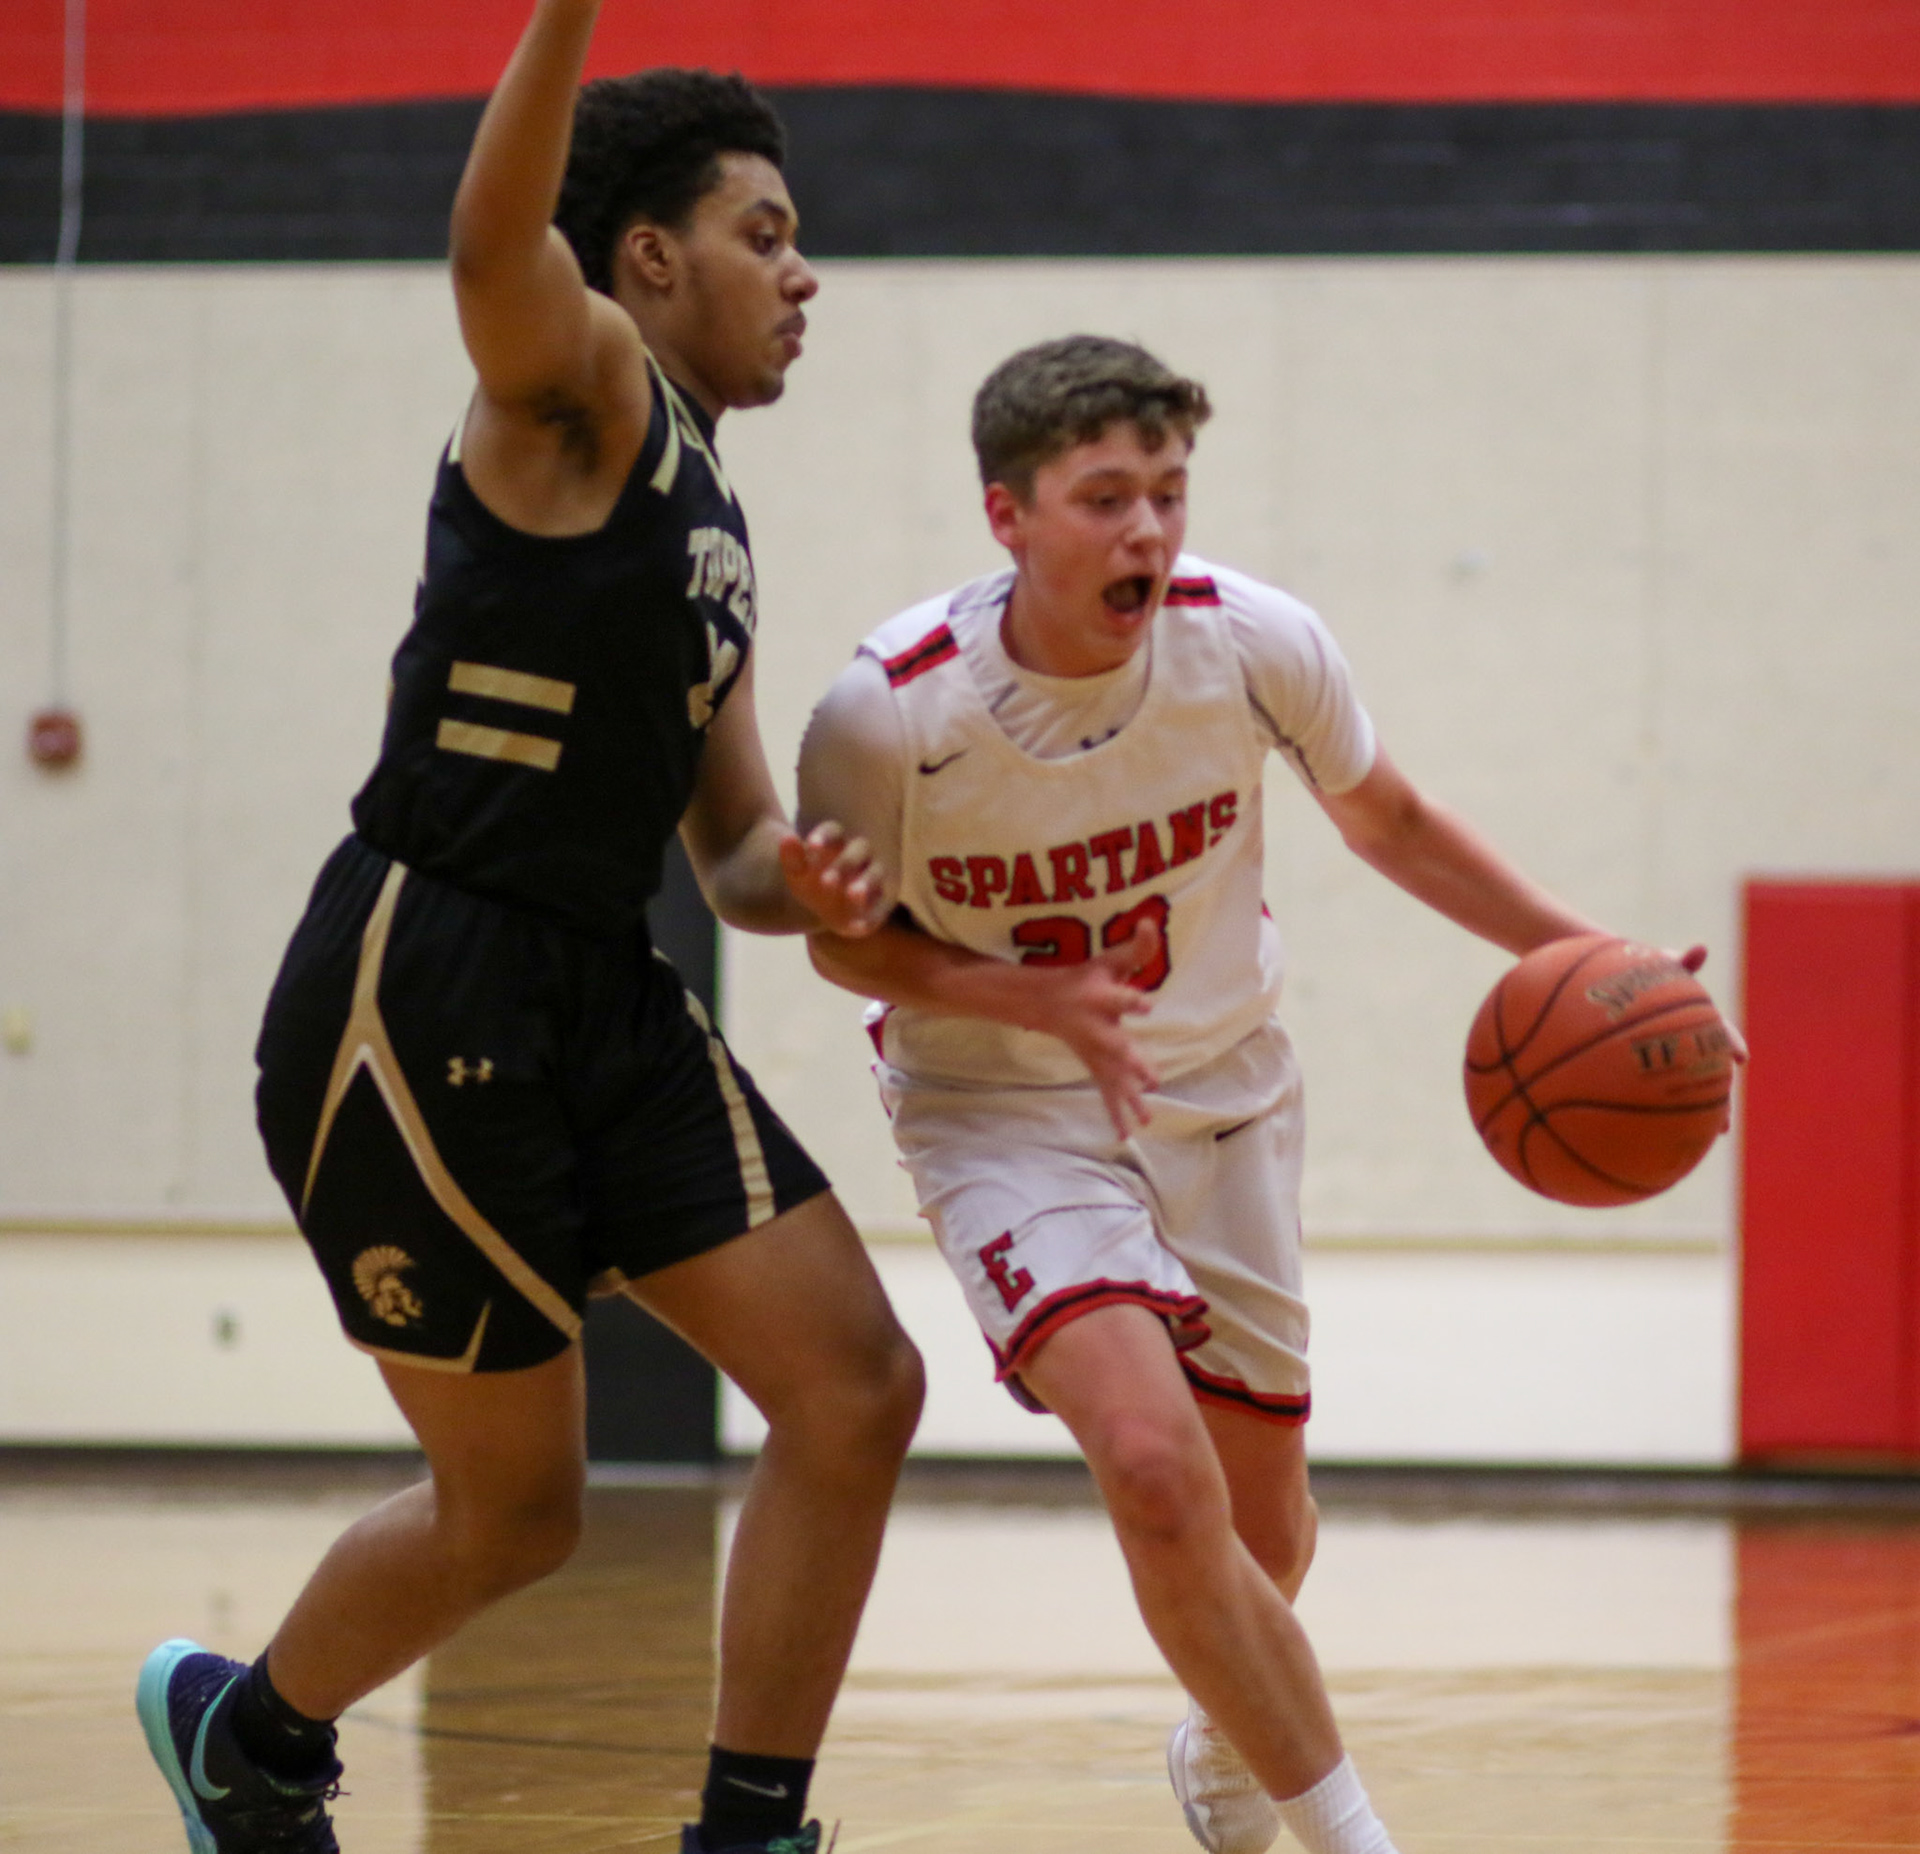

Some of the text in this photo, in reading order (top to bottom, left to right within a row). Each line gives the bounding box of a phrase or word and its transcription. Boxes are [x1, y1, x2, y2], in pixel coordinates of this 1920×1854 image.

[686, 526, 757, 638] TOPE
[928, 790, 1237, 909] SPARTANS
[979, 1229, 1036, 1315] E
